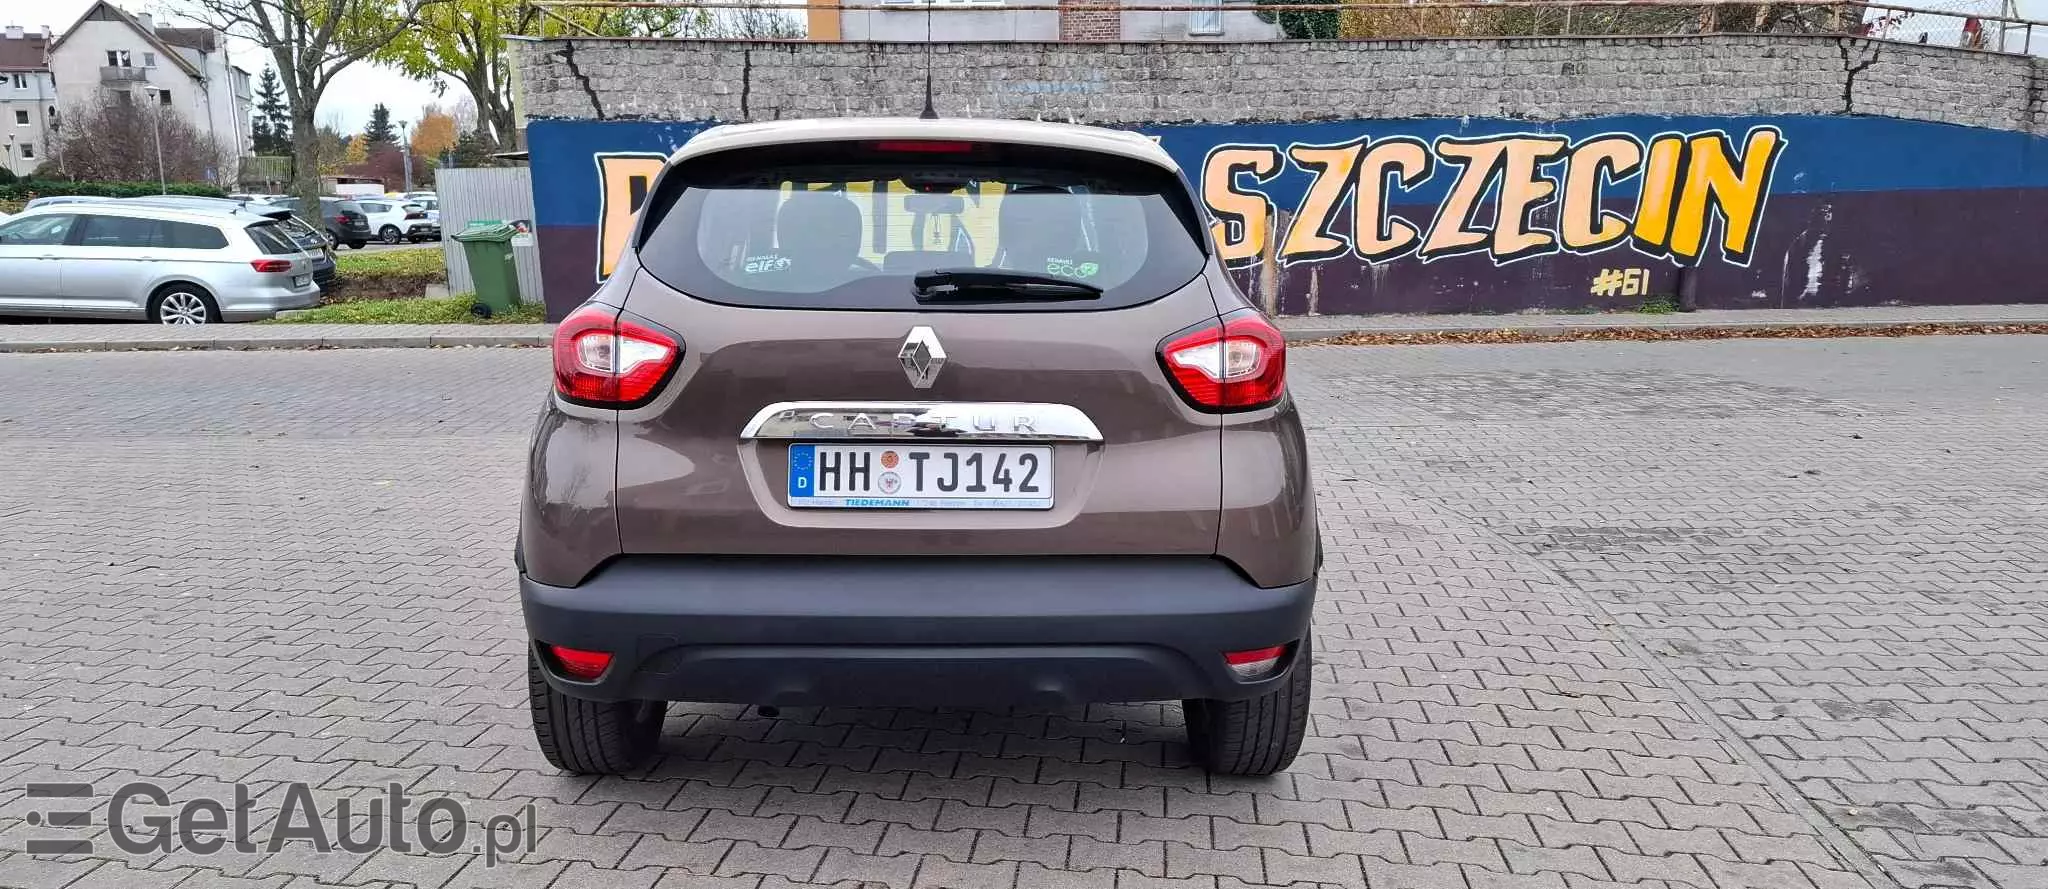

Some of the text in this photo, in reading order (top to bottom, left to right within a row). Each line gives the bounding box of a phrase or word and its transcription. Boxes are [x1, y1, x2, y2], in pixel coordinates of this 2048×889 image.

[1201, 125, 1788, 267] SZCZECIN
[1590, 268, 1650, 297] #61
[809, 412, 1038, 432] CAPTUR
[797, 476, 808, 489] D
[819, 451, 870, 492] HH
[909, 452, 1039, 493] TJ142
[845, 499, 910, 507] TIEDEMANN
